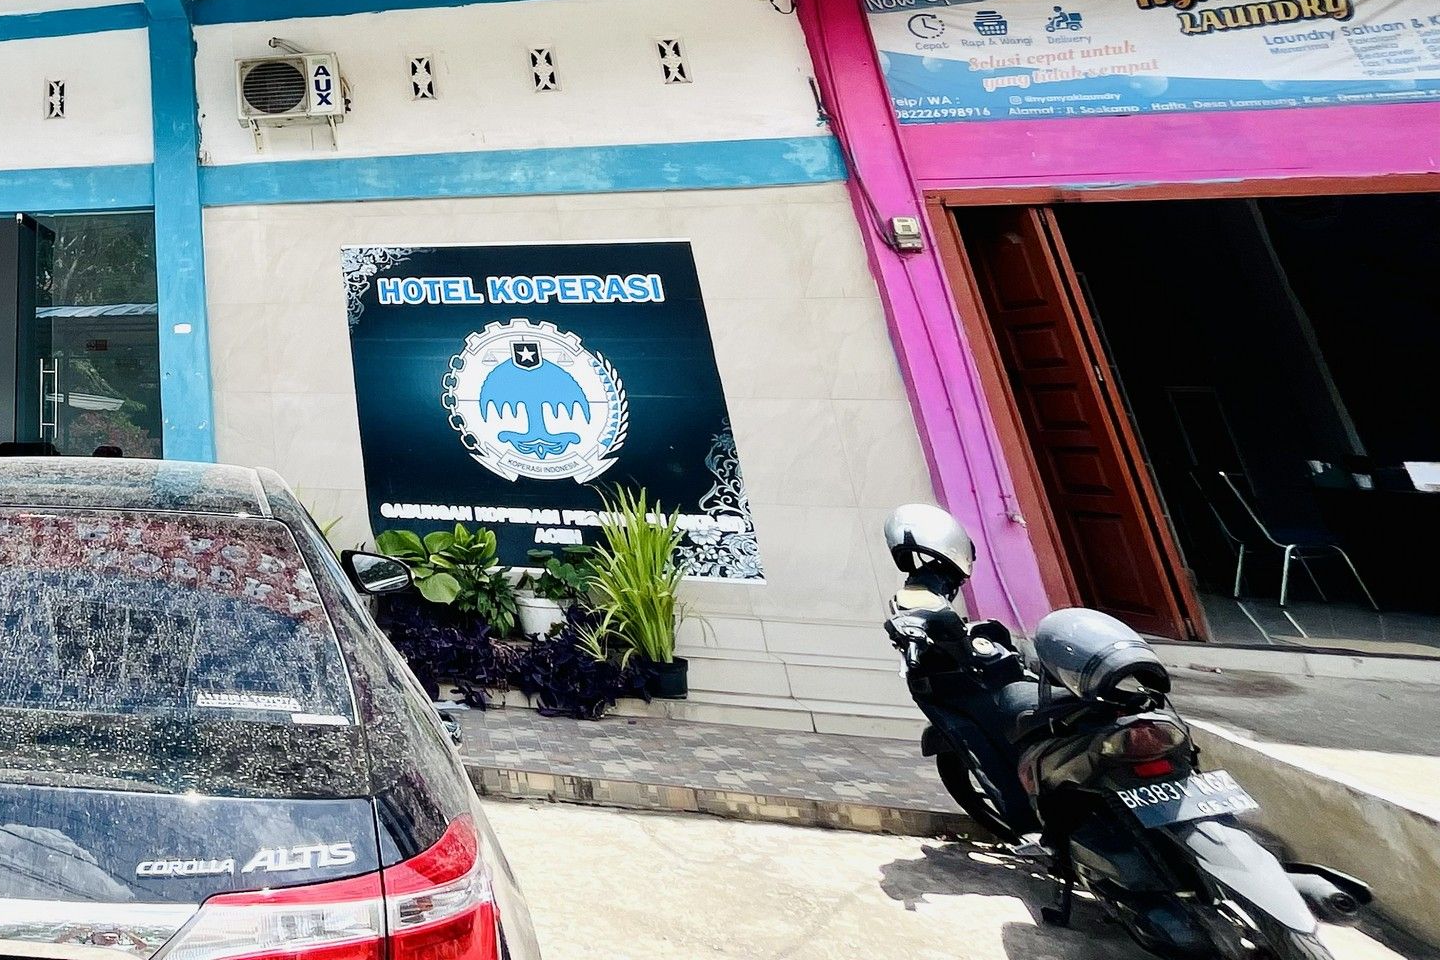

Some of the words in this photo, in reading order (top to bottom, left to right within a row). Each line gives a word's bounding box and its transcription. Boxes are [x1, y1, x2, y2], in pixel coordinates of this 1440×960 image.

[961, 38, 986, 49] Rapi
[1000, 36, 1034, 47] Wangi
[1046, 35, 1092, 44] Delivery
[1262, 29, 1336, 46] Laundry
[1340, 21, 1407, 37] Satuan
[915, 41, 950, 52] Cepat
[969, 53, 1021, 71] Solusi
[1027, 48, 1074, 66] cepat
[1080, 40, 1137, 59] untuk
[984, 75, 1030, 91] yang
[1086, 58, 1160, 77] sempat
[313, 65, 333, 106] AUX
[927, 96, 953, 105] WA
[1009, 106, 1054, 115] Alamat
[377, 276, 484, 304] HOTEL
[488, 273, 665, 304] KOPERASI
[507, 459, 543, 473] KOPERASI
[543, 460, 579, 473] INDONESIA
[136, 858, 235, 876] COROLLA
[240, 842, 357, 874] ALTIS
